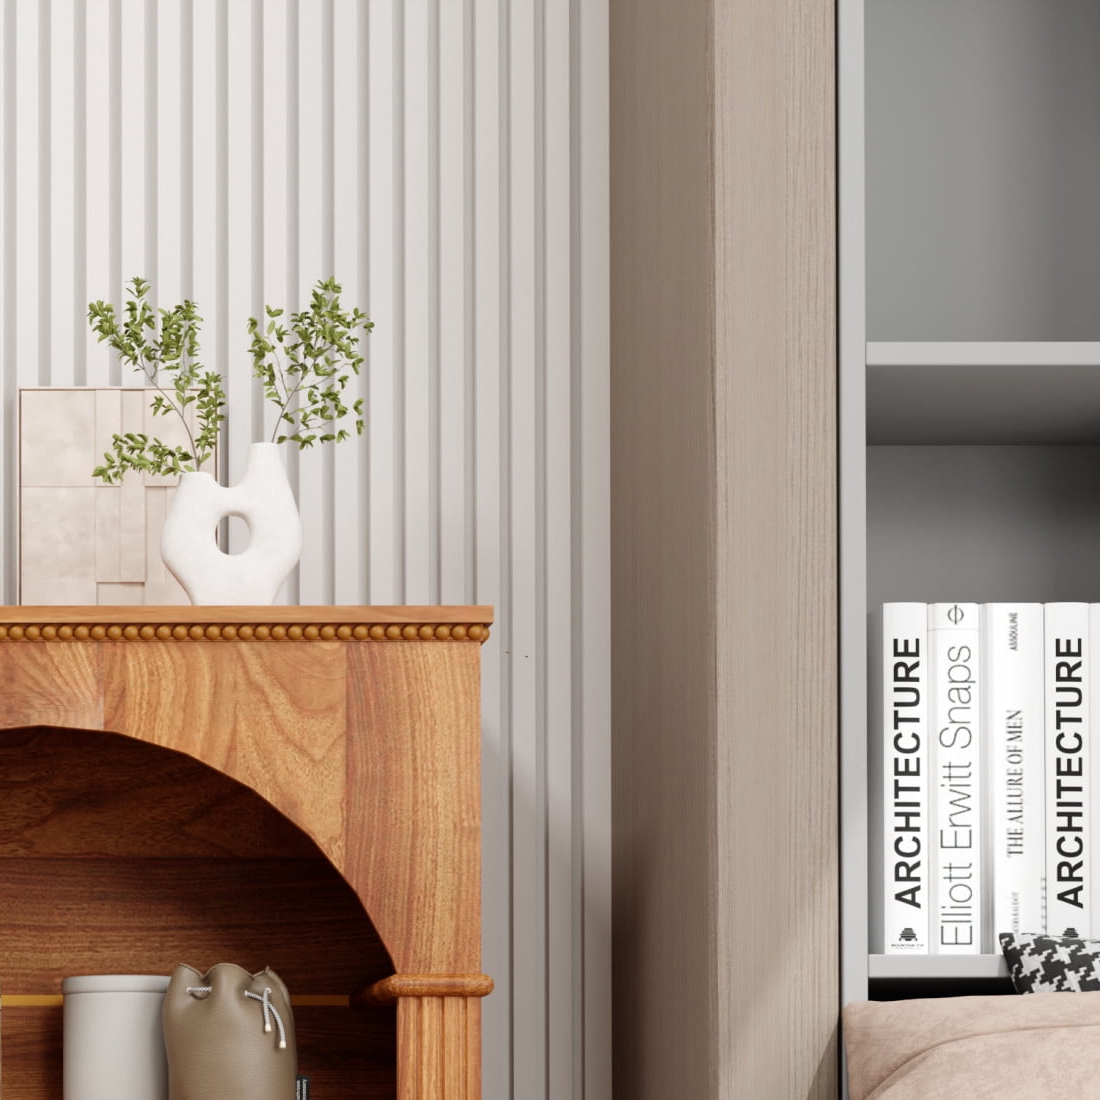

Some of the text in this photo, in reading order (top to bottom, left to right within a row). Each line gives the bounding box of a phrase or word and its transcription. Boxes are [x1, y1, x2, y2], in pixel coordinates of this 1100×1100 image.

[893, 637, 922, 909] ARCHITECTURE
[939, 644, 976, 946] Elliott Erwitt Snaps
[1006, 709, 1024, 857] THE ALLURE OF MEN
[1055, 637, 1084, 909] ARCHITECTURE
